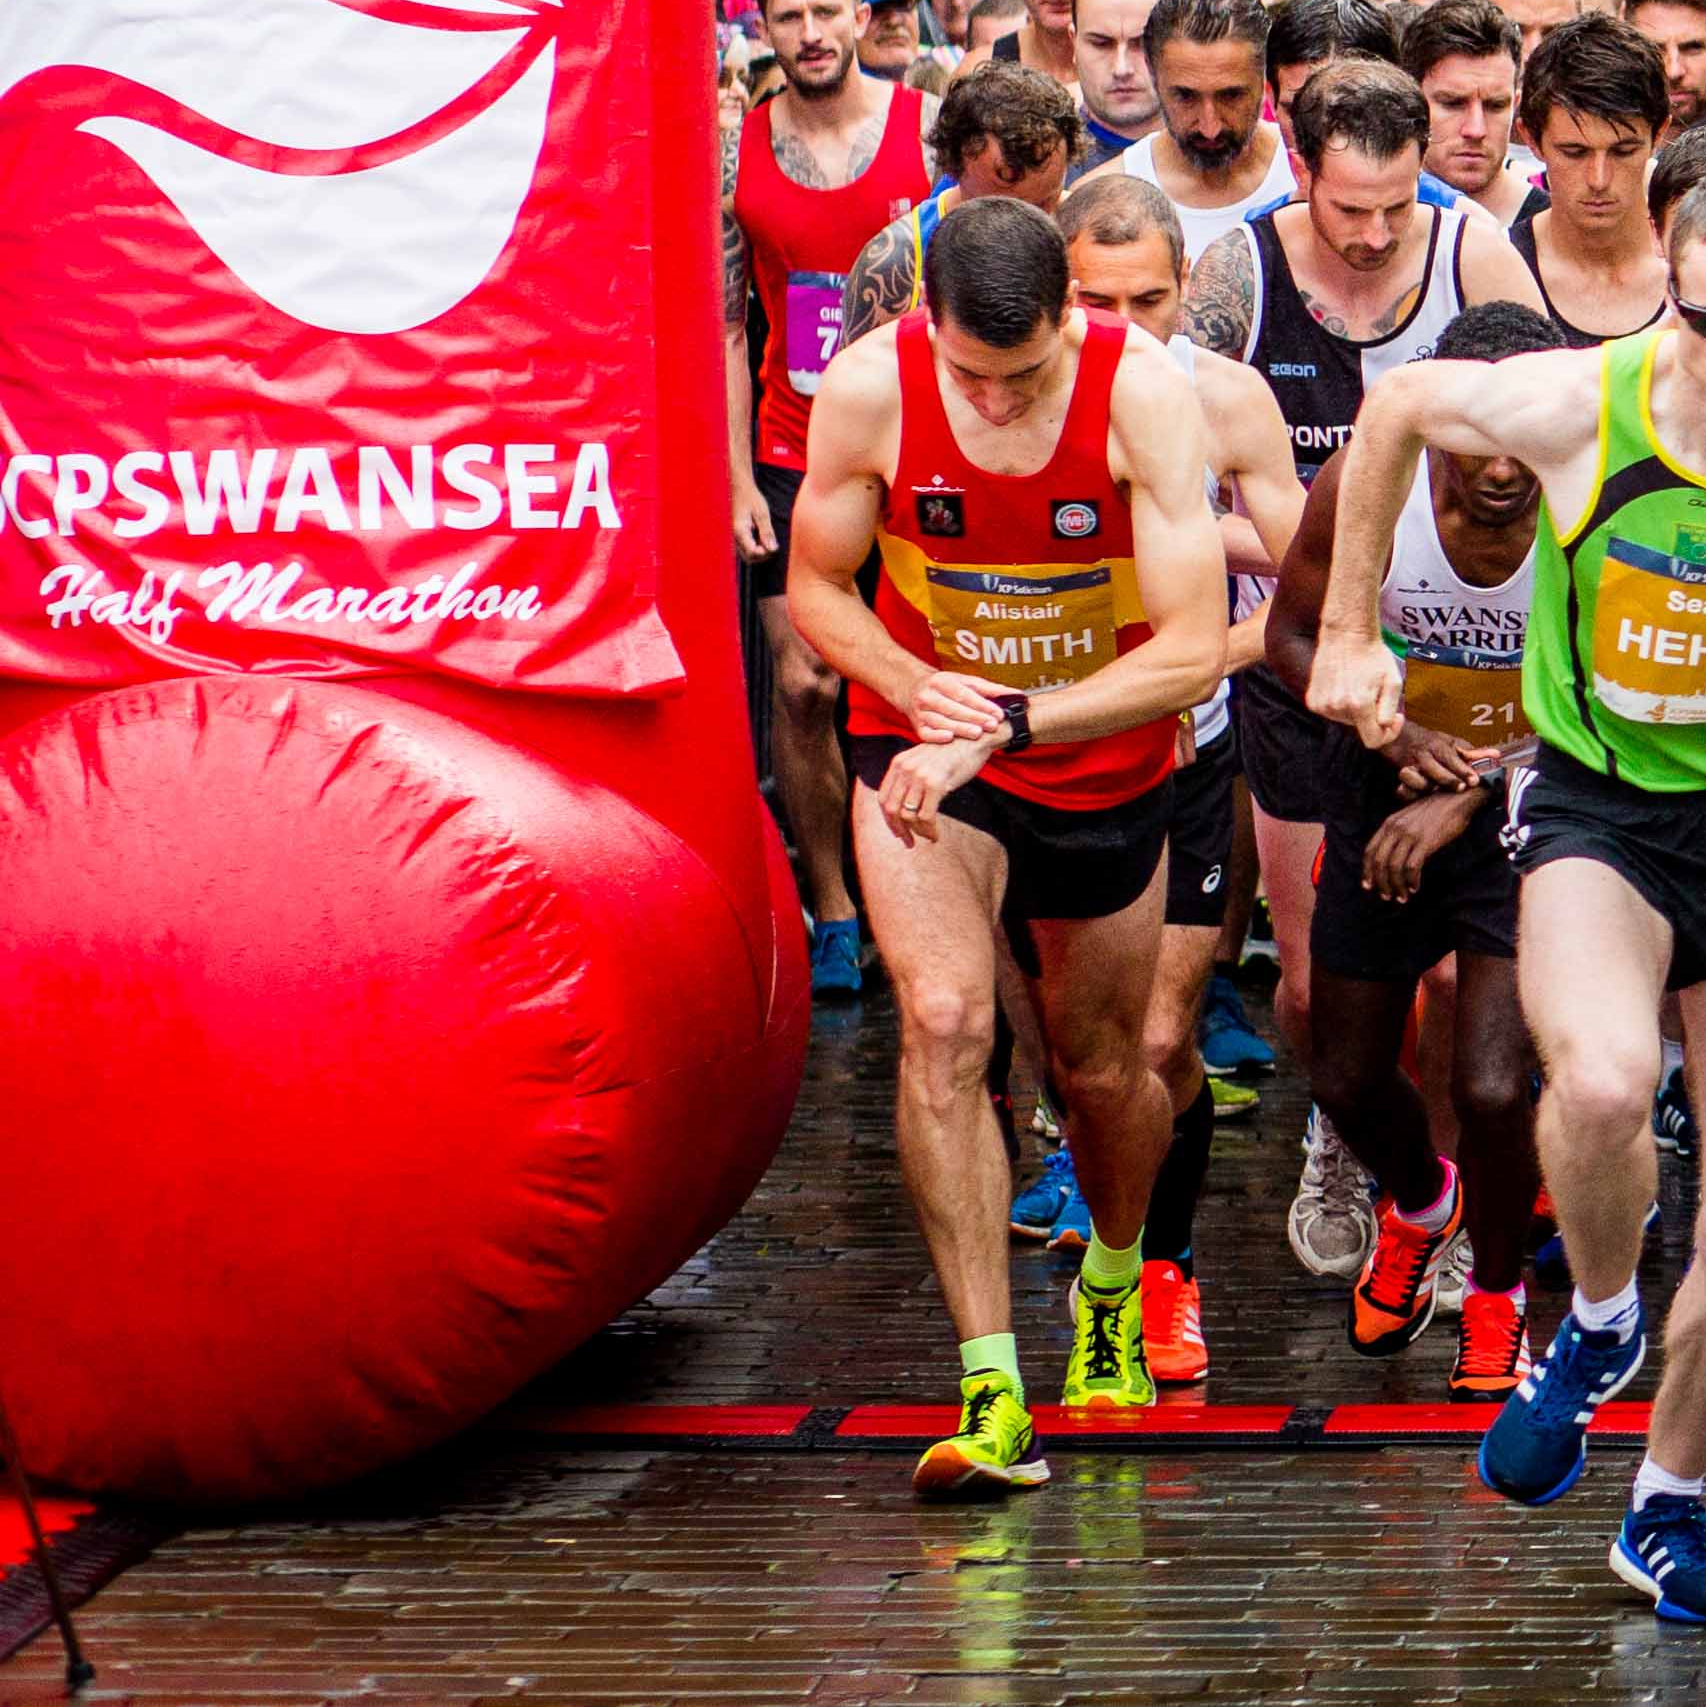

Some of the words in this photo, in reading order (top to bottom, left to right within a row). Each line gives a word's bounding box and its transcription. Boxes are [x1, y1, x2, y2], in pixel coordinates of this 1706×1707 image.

[0, 442, 622, 540] CPSWANSEA
[39, 563, 184, 644] Half
[197, 561, 543, 625] Marathon
[973, 601, 1065, 620] Alistair
[1401, 605, 1530, 631] SWANS
[954, 628, 1094, 665] SMITH
[1470, 701, 1515, 727] 21
